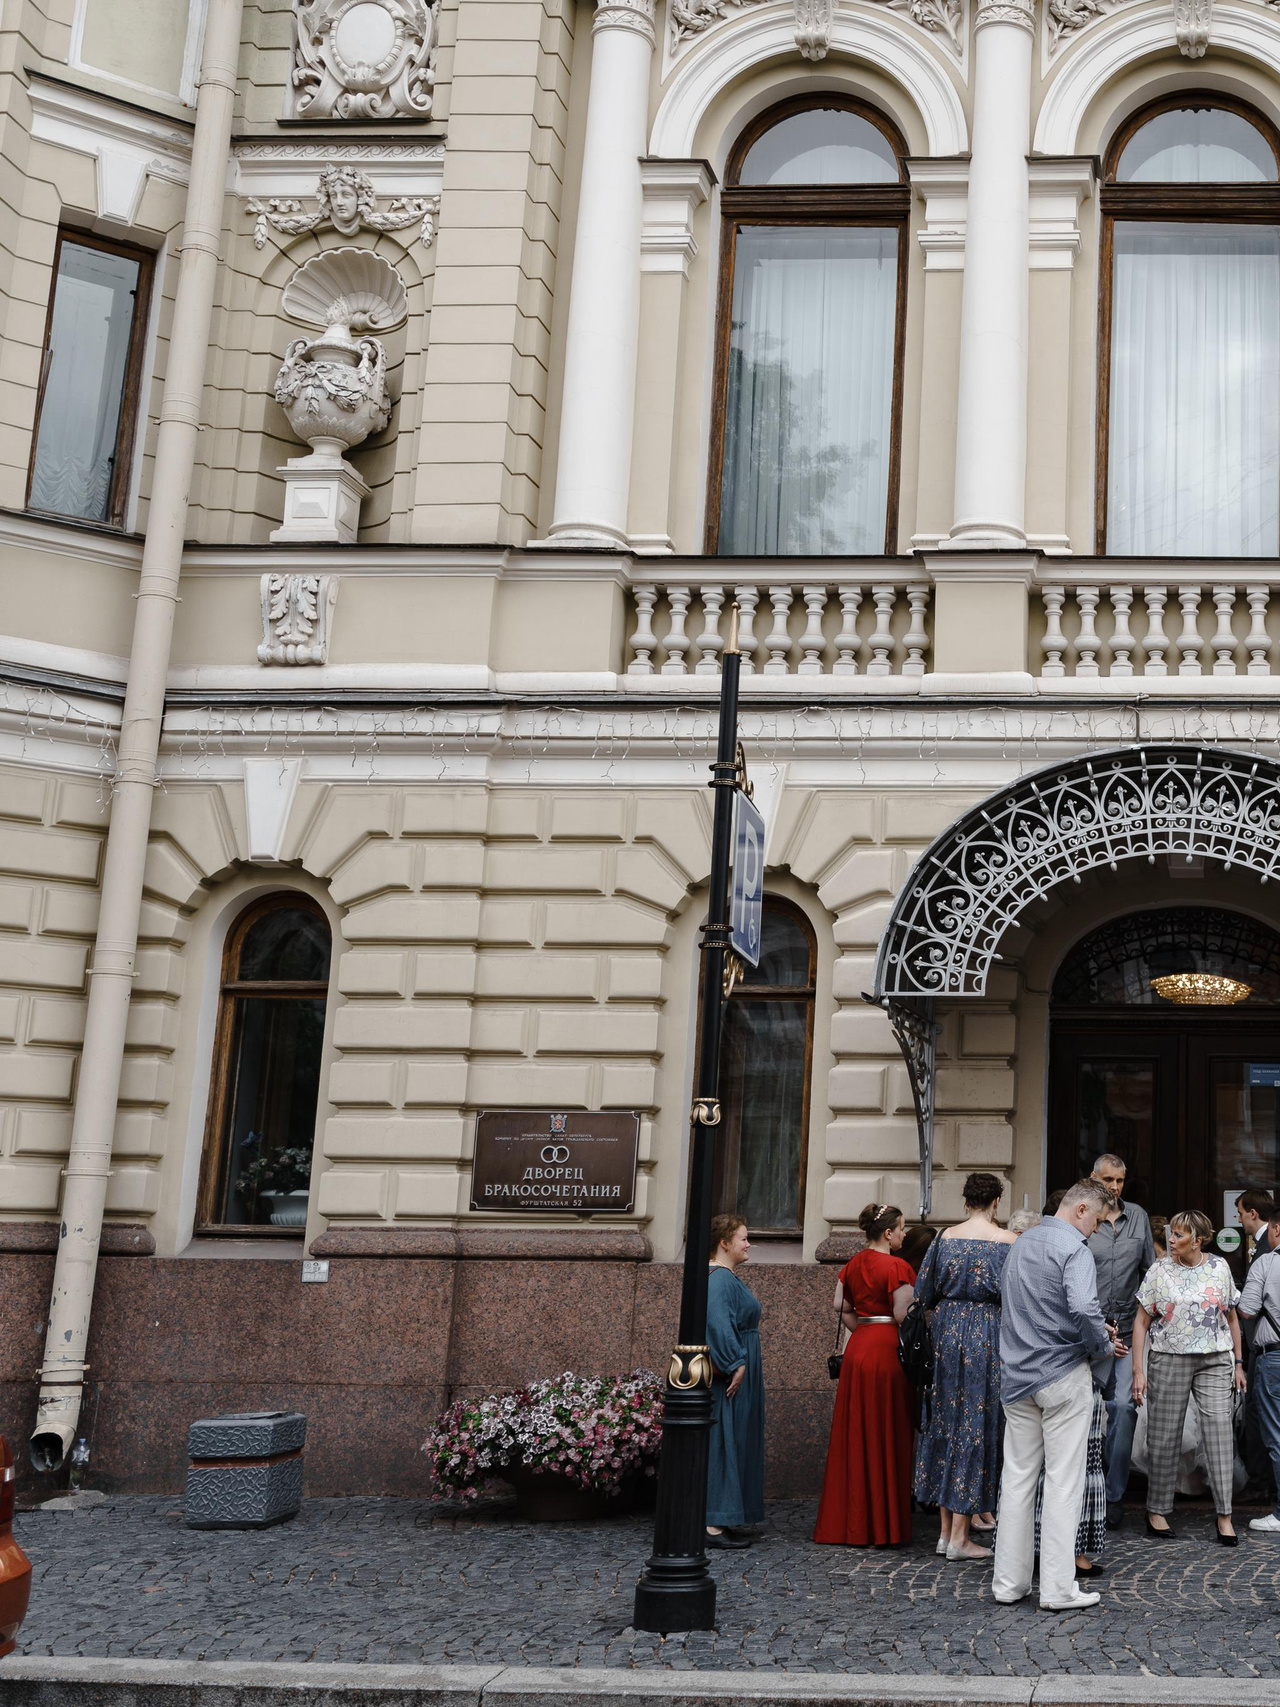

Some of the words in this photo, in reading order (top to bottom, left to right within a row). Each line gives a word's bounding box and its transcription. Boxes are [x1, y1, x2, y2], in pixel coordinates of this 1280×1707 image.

[522, 1167, 584, 1180] ДВОРЕЦ
[484, 1184, 621, 1197] БРАКОСОЧЕТАНИЯ
[572, 1199, 583, 1207] 52
